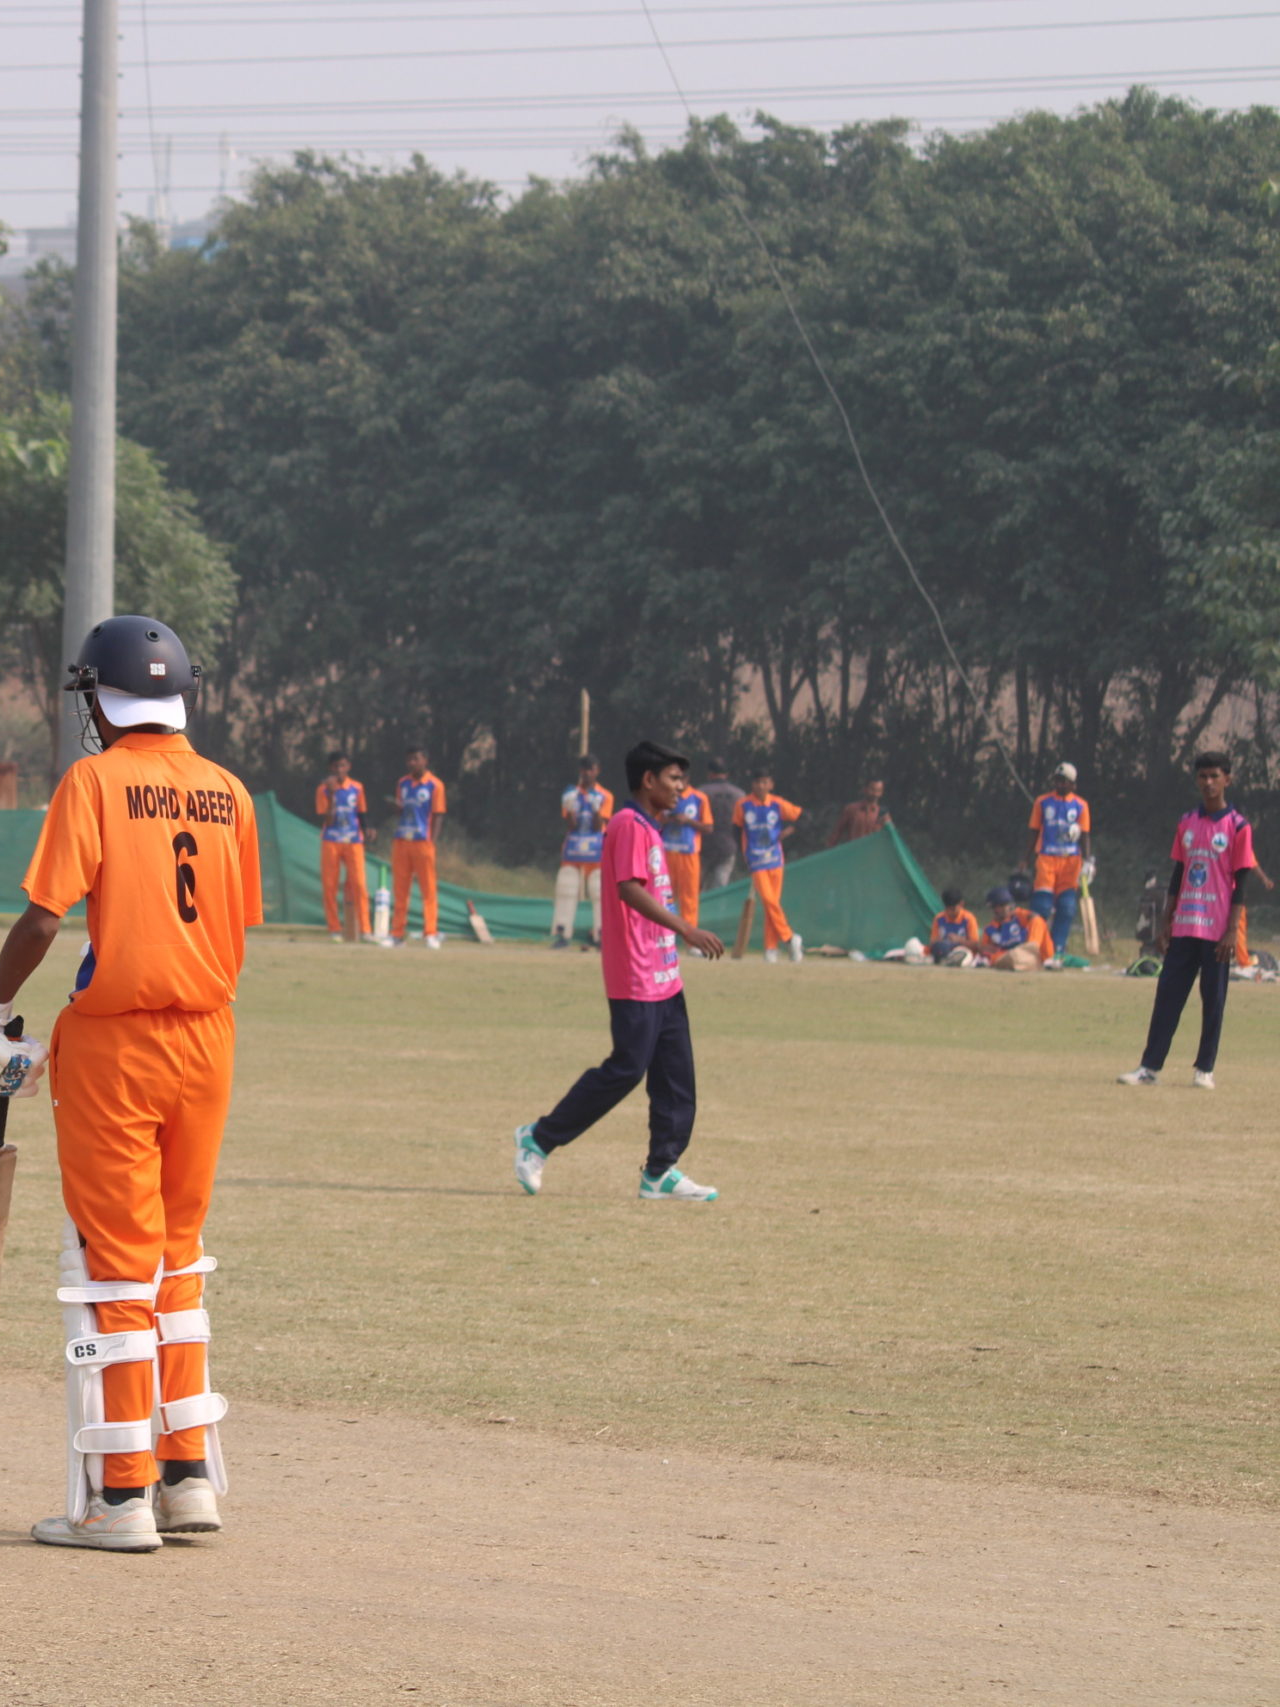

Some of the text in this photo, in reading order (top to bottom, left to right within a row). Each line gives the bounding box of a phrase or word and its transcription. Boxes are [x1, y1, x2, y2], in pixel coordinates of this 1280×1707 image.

[125, 785, 234, 826] MOHD ABEER
[172, 831, 198, 924] 6
